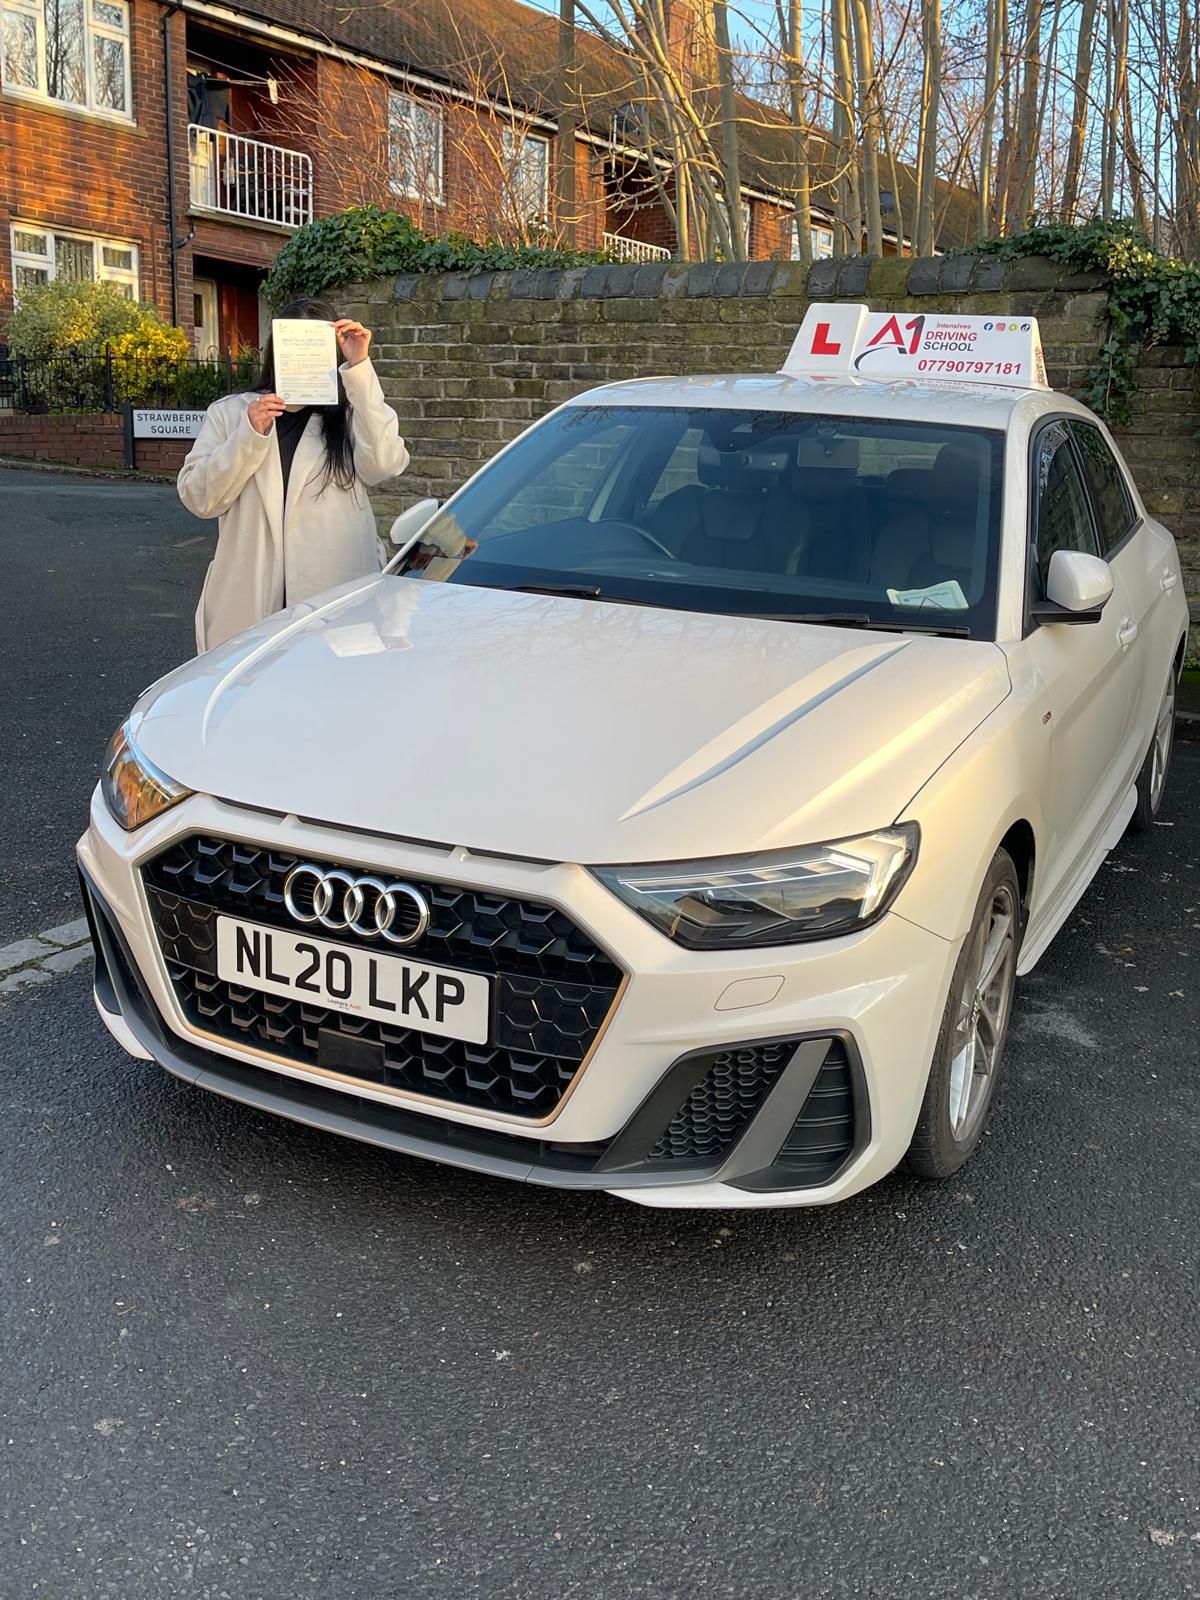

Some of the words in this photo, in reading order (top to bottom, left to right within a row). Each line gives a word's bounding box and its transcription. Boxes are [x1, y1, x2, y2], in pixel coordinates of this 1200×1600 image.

[810, 323, 841, 355] L
[866, 315, 926, 355] A1
[925, 331, 977, 341] DRIVING
[923, 341, 974, 352] SCHOOL
[917, 359, 1022, 375] 07790797181
[136, 413, 204, 422] STRAWBERRY
[150, 425, 191, 434] SQUARE
[236, 926, 352, 1000] NL20
[369, 959, 465, 1023] LKP
